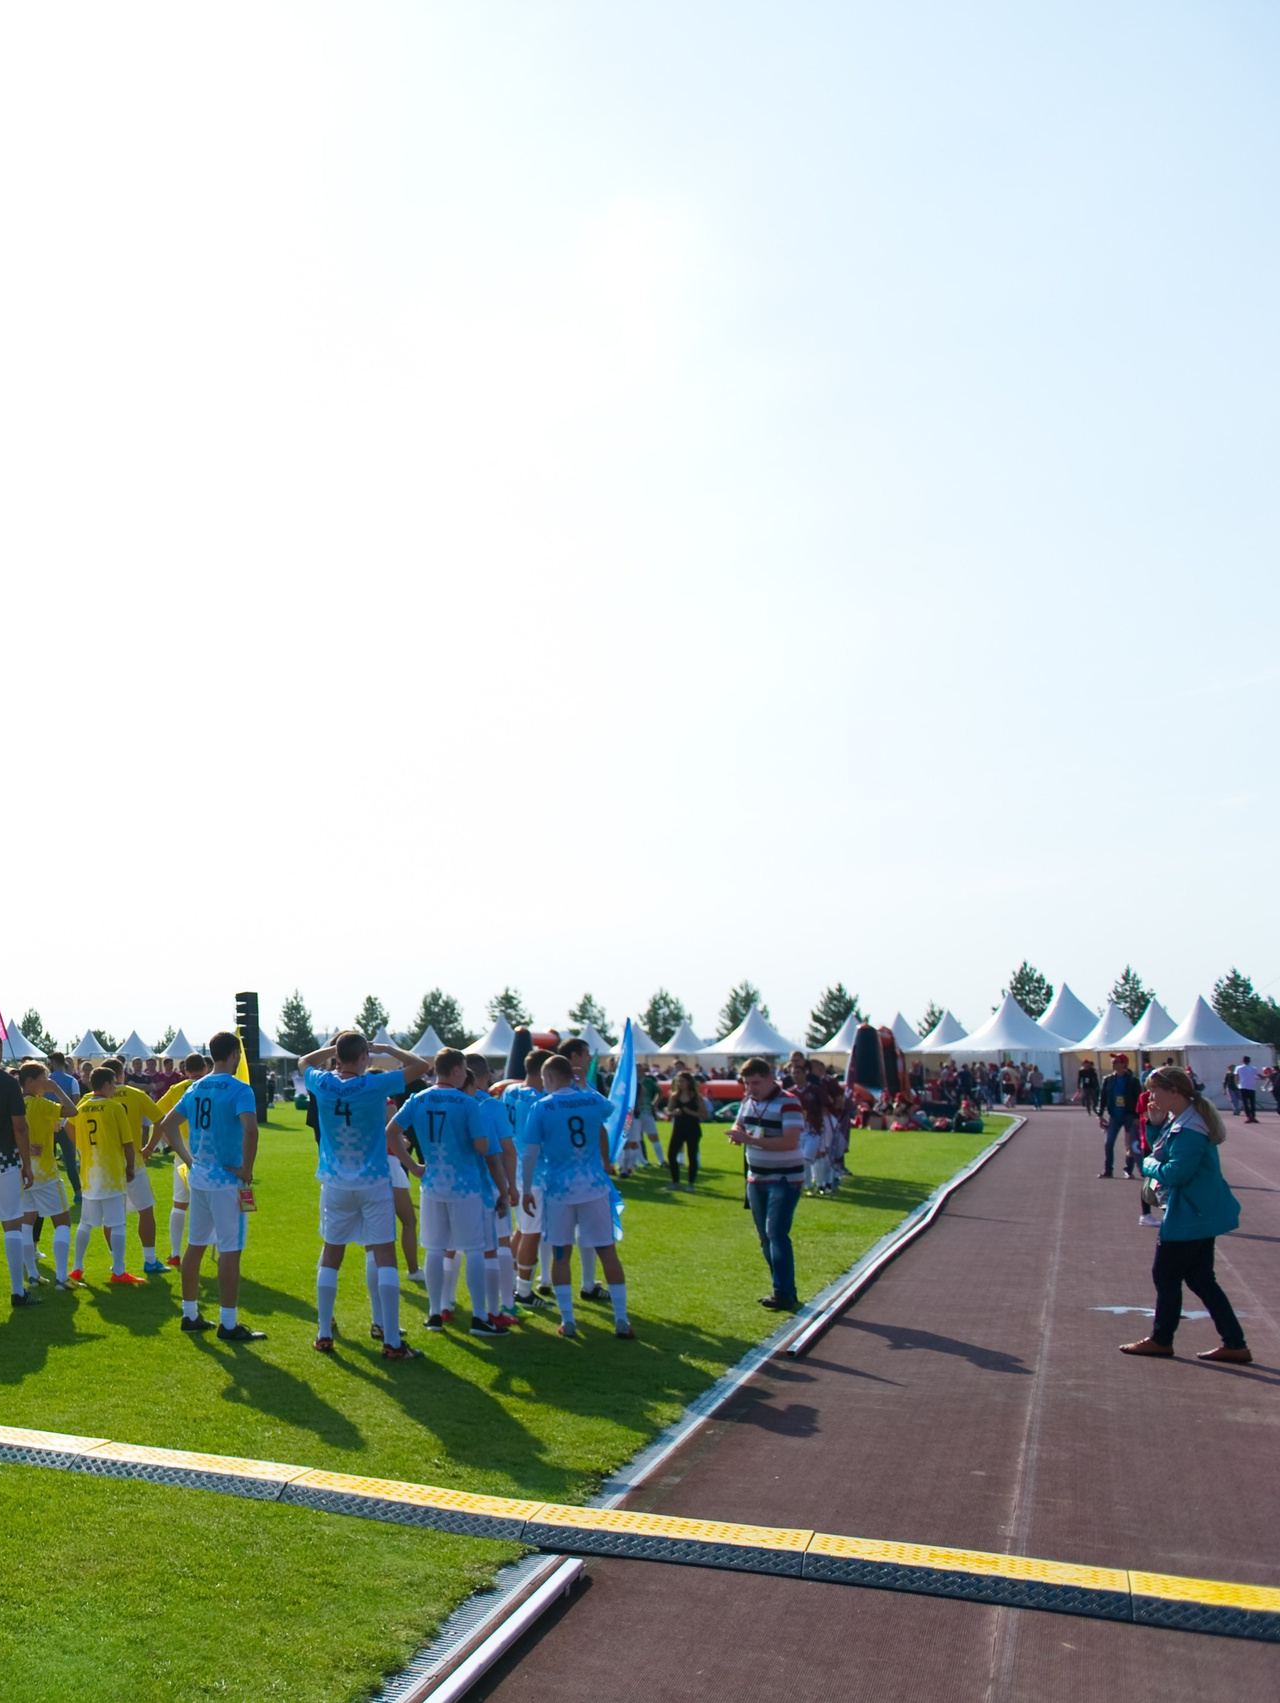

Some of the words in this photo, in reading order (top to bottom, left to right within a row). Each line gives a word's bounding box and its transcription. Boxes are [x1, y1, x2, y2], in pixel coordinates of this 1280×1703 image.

[194, 1097, 212, 1130] 18
[334, 1098, 353, 1127] 4
[426, 1110, 447, 1144] 17
[87, 1119, 97, 1145] 2
[568, 1116, 587, 1148] 8
